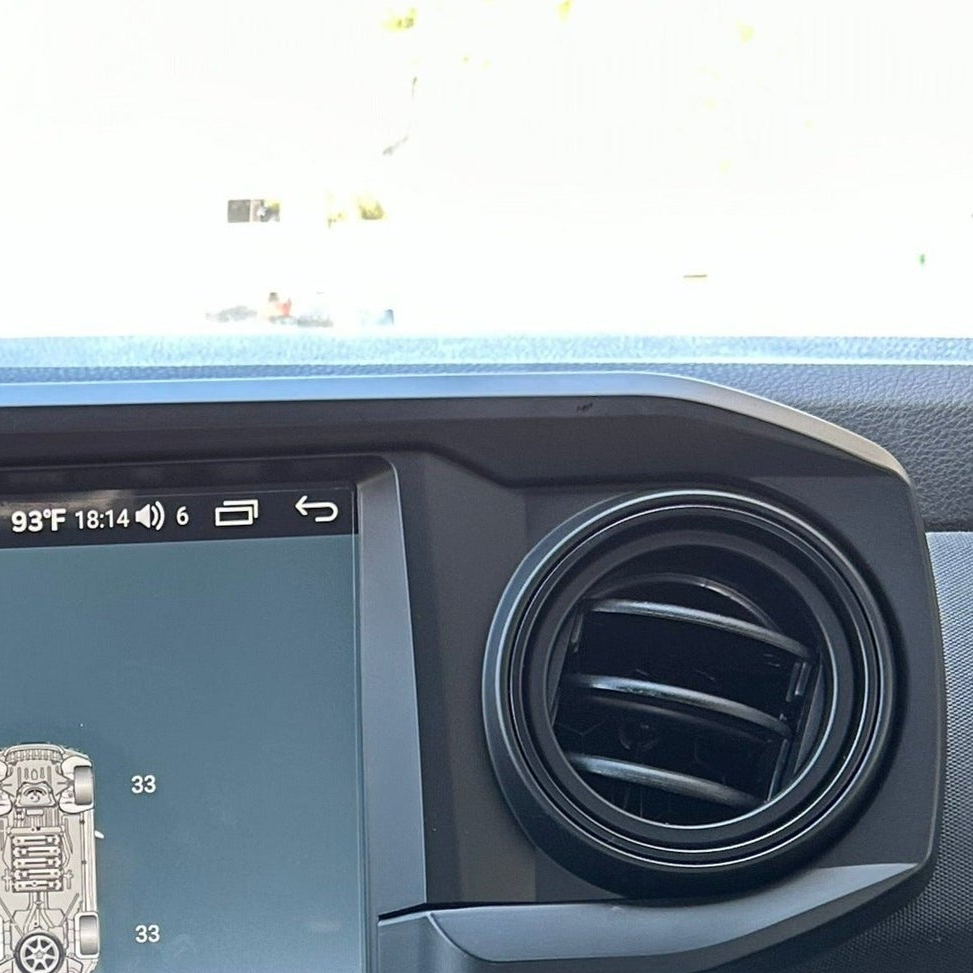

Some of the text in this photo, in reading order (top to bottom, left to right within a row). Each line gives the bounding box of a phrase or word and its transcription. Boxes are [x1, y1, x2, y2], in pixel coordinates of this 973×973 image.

[75, 508, 130, 530] 18:14
[176, 505, 189, 526] 6
[131, 775, 157, 794] 33
[134, 924, 160, 943] 33
